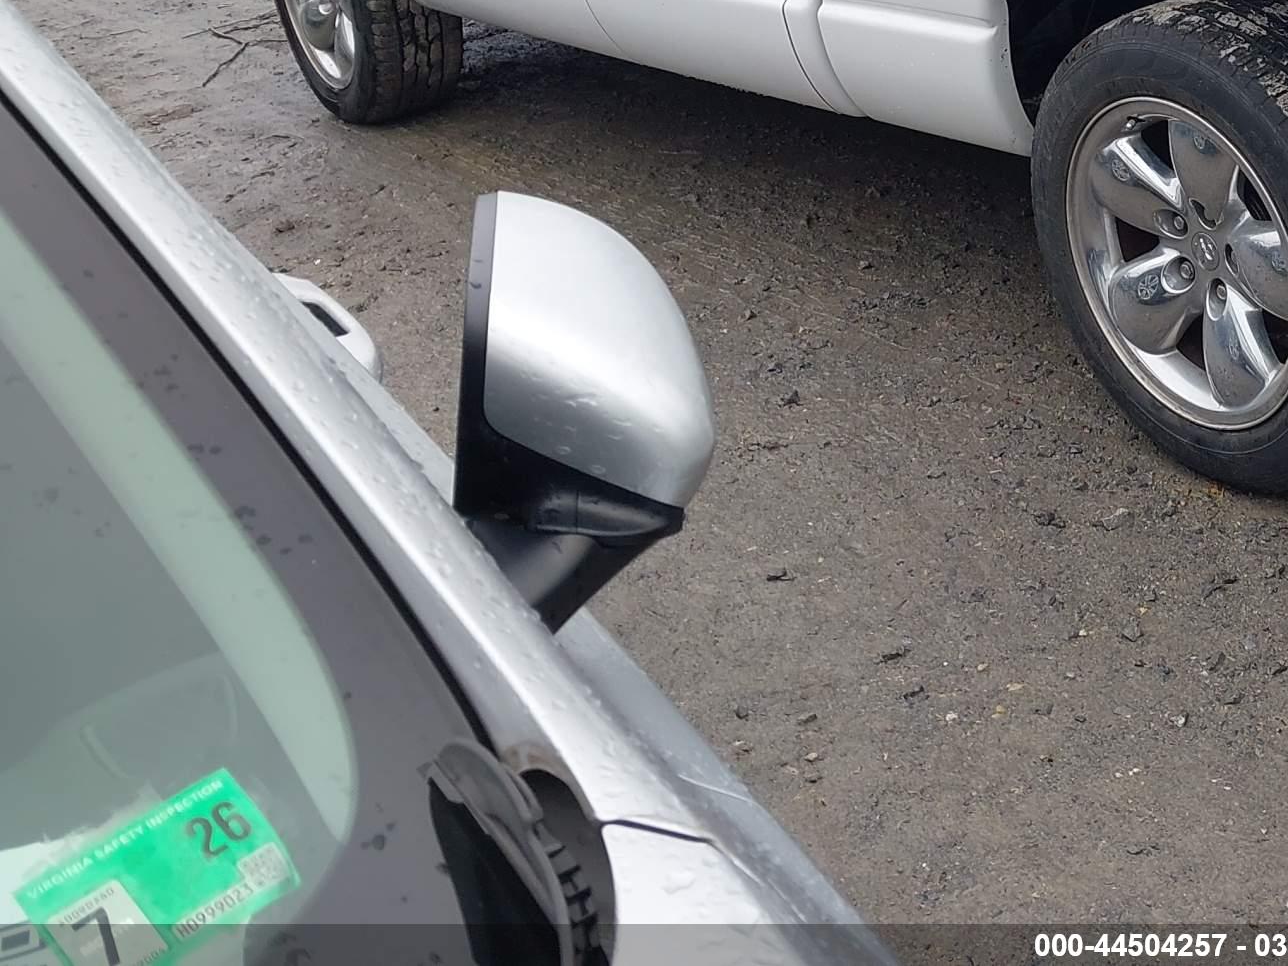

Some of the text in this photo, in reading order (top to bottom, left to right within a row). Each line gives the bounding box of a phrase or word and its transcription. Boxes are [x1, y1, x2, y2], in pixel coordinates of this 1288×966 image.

[27, 778, 224, 900] VIRGINIA SAFETY INSPECTION
[186, 801, 252, 859] 26
[72, 906, 121, 966] 7
